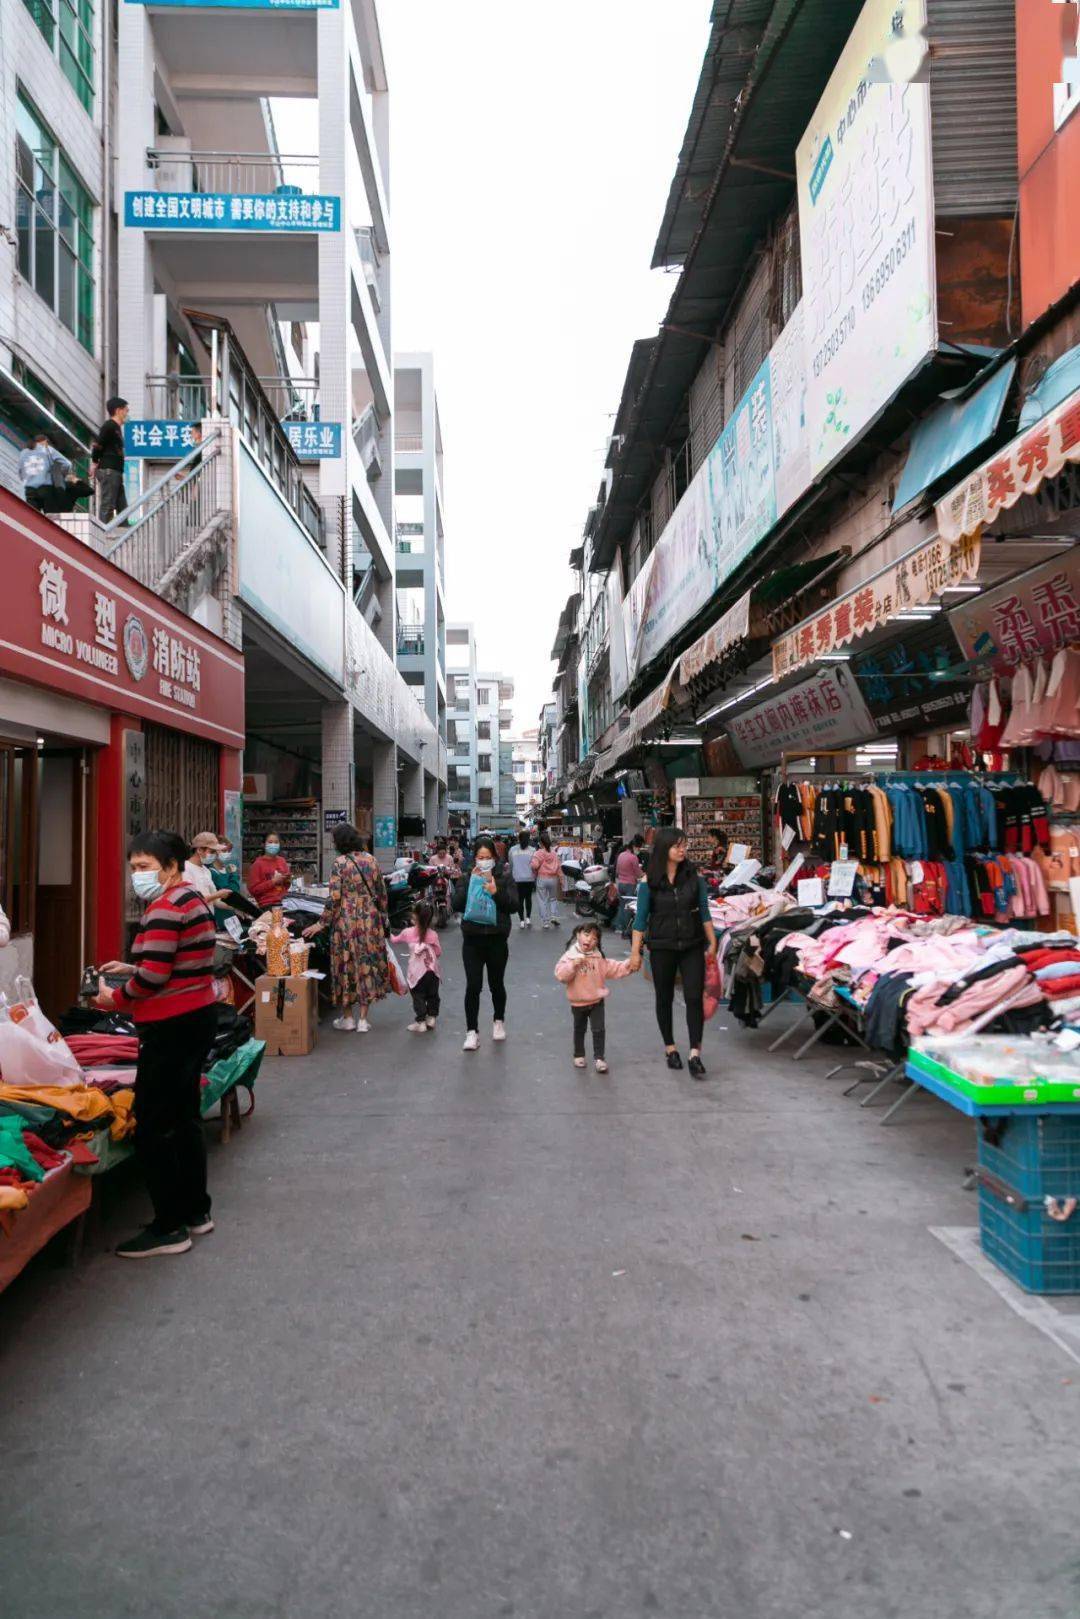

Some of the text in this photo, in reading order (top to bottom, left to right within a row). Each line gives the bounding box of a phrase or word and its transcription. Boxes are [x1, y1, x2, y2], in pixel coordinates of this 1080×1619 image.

[132, 196, 334, 222] 创建全国文明城市 需要你的支持和参与
[132, 424, 334, 448] 社会平安 居乐业
[41, 622, 74, 655] MICRO
[800, 587, 874, 661] 柔秀童装
[152, 627, 201, 693] 消防站
